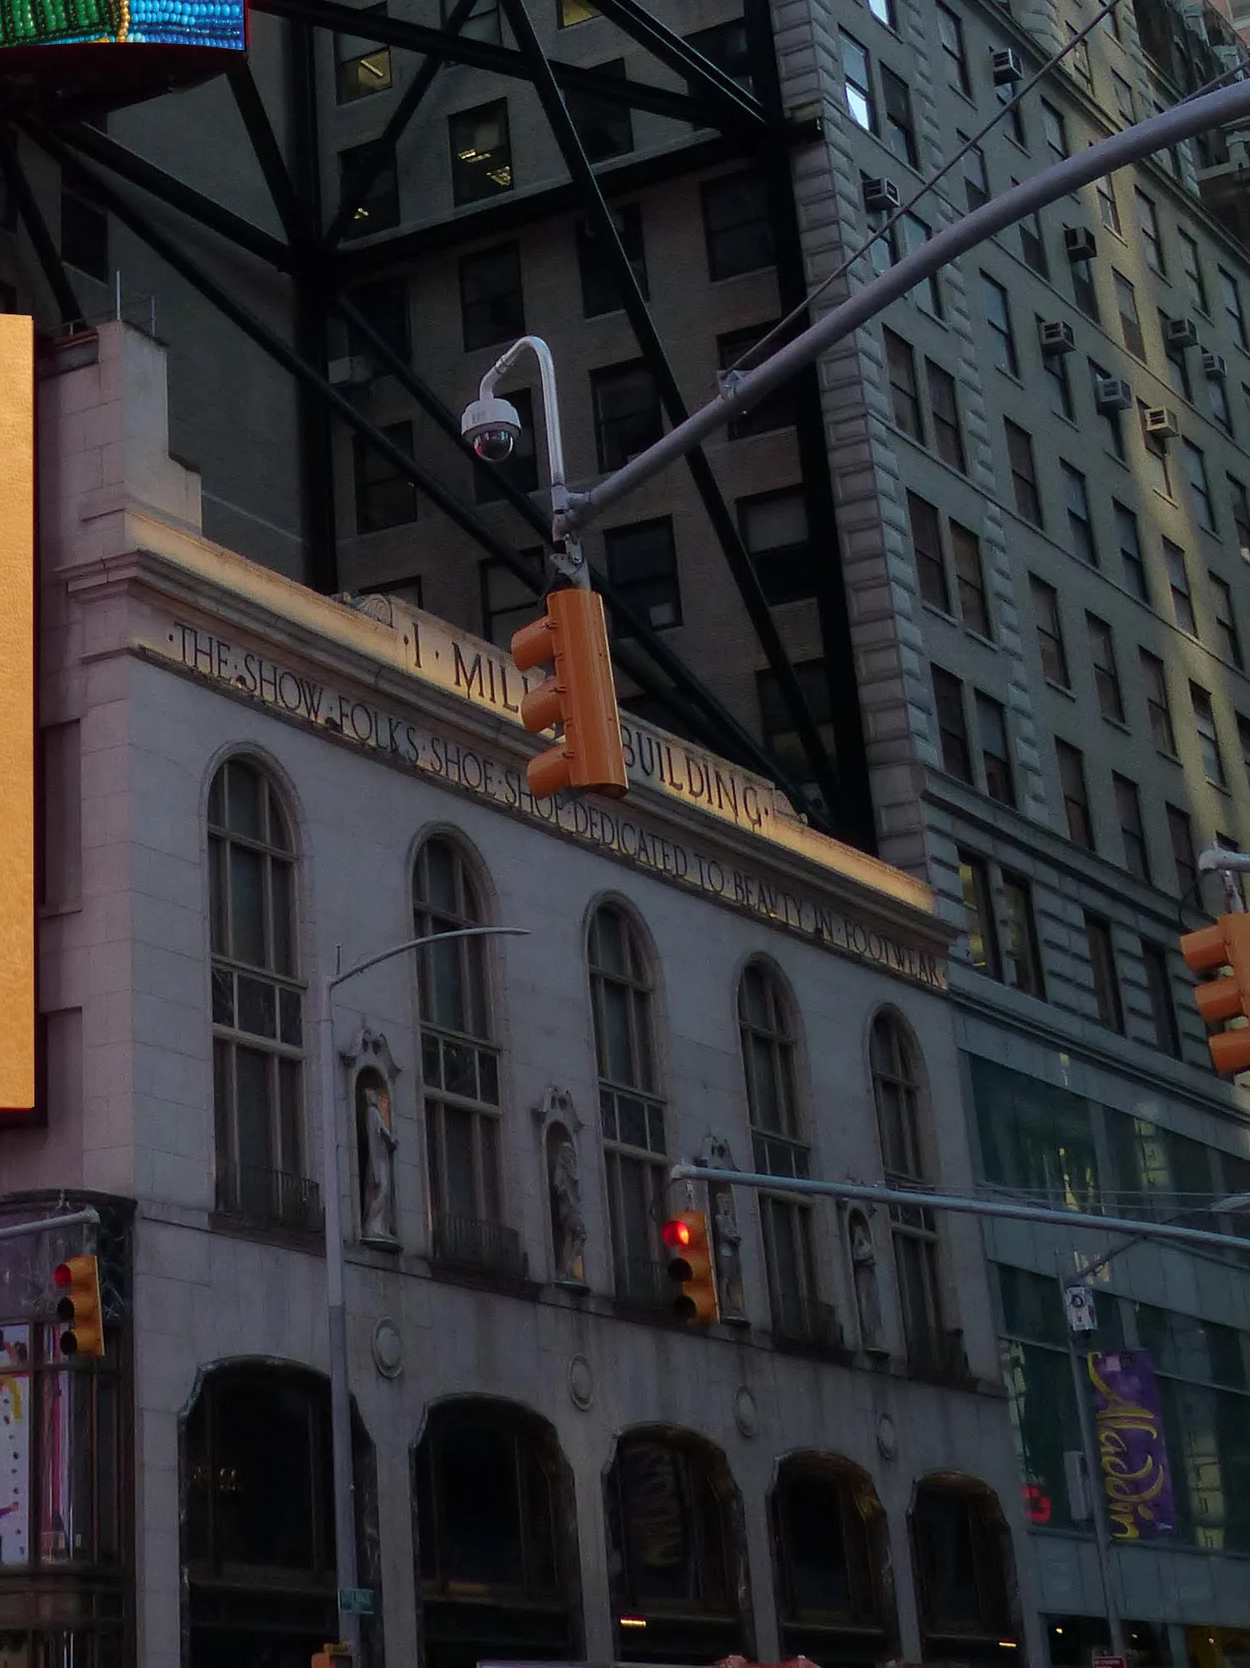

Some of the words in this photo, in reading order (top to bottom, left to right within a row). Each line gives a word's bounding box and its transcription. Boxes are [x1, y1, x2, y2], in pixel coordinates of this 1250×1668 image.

[174, 621, 232, 683] THE
[244, 654, 324, 722] SHOW
[338, 695, 420, 765] FOLKS
[430, 737, 497, 798] SHOE
[573, 800, 688, 877] DEDICATED
[694, 853, 725, 895] TO
[843, 919, 941, 985] FOOTWEAR
[452, 642, 529, 713] MIL
[620, 723, 762, 828] BUILDING
